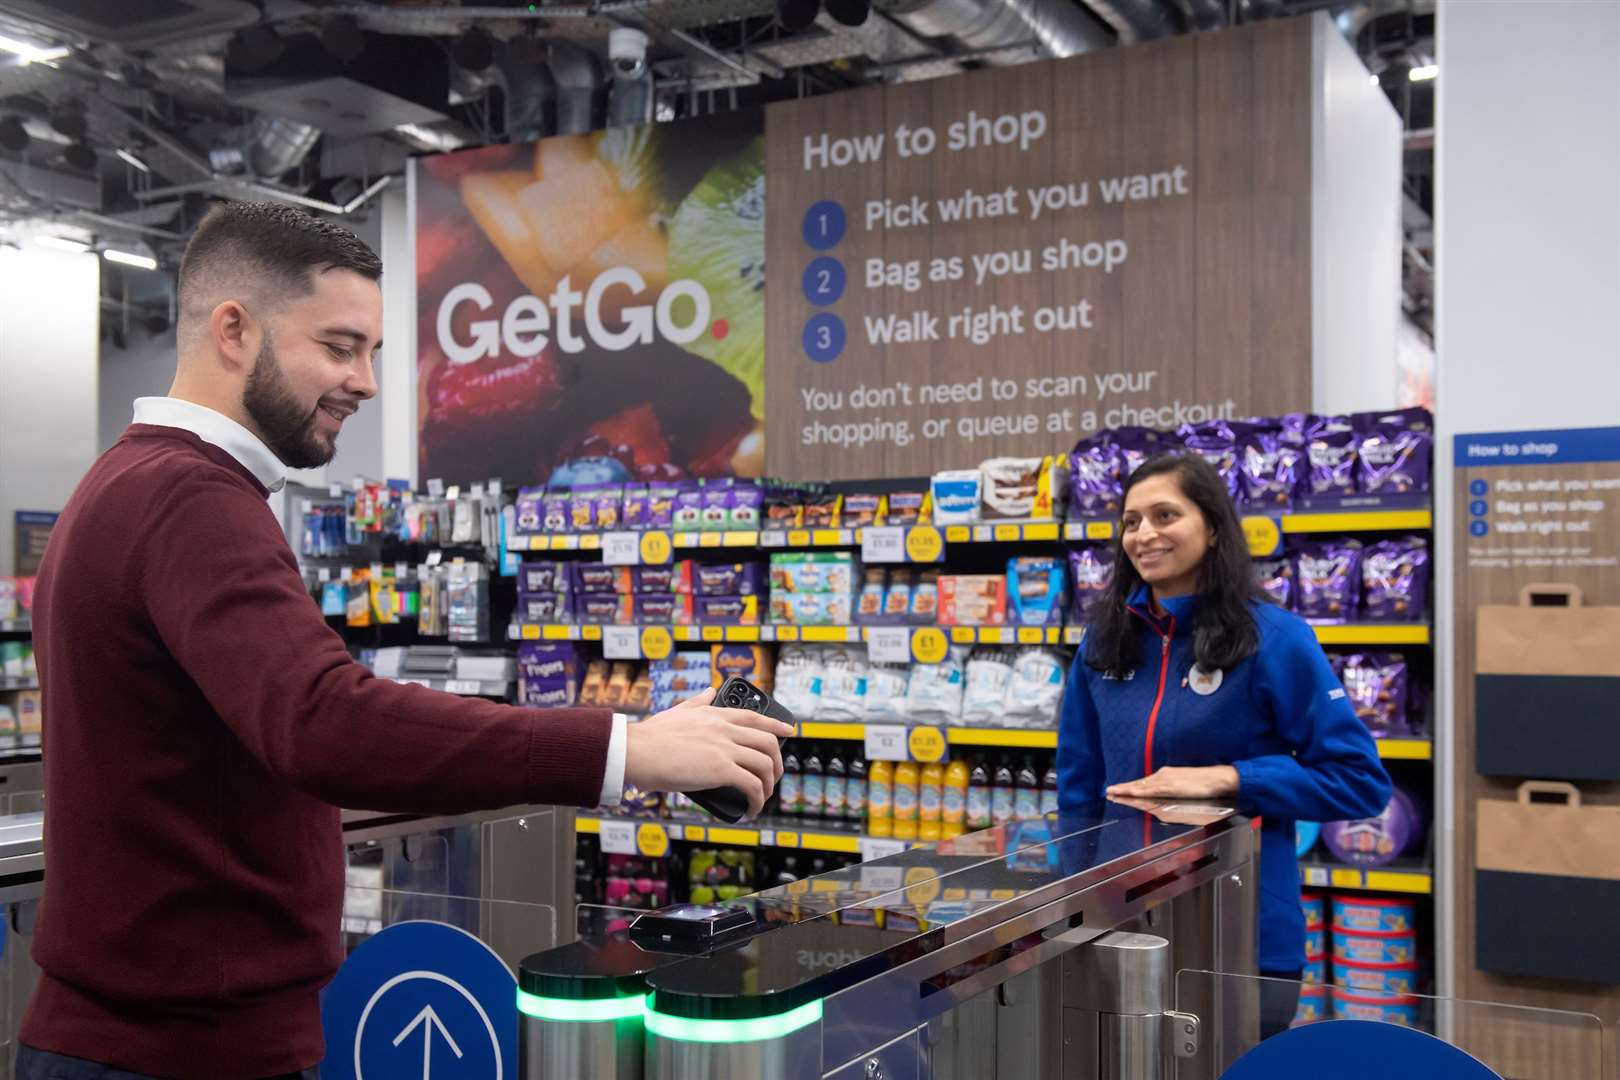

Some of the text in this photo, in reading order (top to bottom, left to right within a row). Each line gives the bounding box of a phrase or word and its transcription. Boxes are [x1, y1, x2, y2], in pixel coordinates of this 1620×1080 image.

[803, 110, 1047, 170] How to shop
[818, 164, 1188, 236] 1 Pick what you want
[816, 237, 1128, 293] 2 Bag as you shop
[436, 266, 729, 364] GetGo.
[816, 299, 1093, 350] 3 Walk right out
[801, 369, 1156, 411] You don't need to scan your
[801, 418, 916, 449] shopping,
[922, 415, 946, 438] or
[957, 412, 1040, 441] queue
[1046, 408, 1072, 433] at
[1081, 409, 1097, 431] a
[1468, 442, 1558, 457] How to shop
[1541, 502, 1566, 513] you
[1568, 500, 1605, 513] shop
[1563, 480, 1589, 492] you
[920, 636, 935, 649] £1
